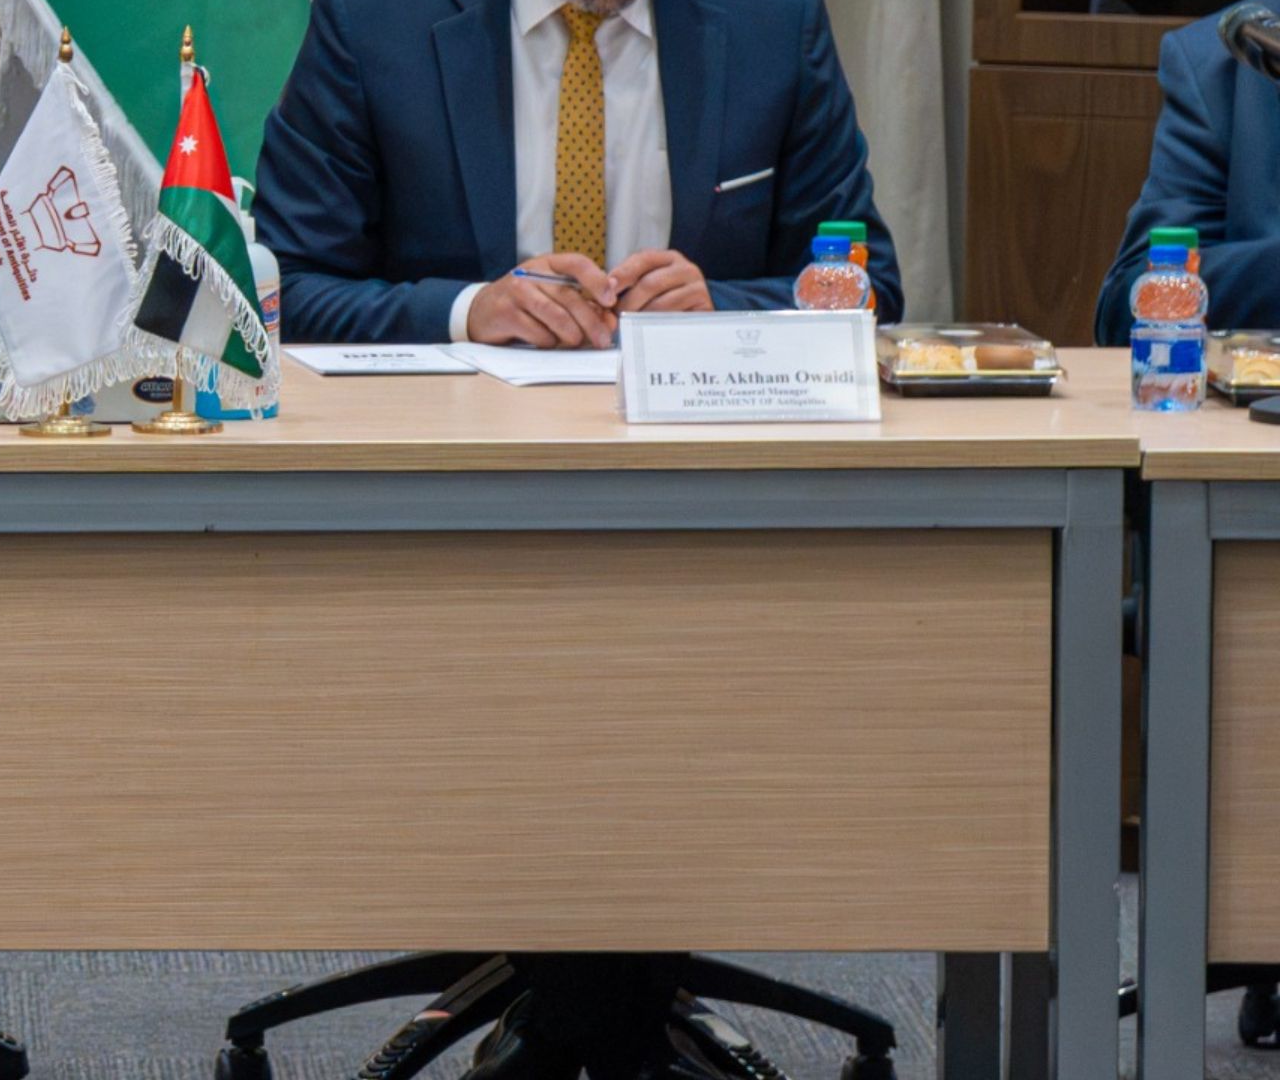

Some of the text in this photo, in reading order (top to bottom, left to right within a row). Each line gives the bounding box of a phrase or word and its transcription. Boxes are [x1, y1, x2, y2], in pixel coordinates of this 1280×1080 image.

[1, 237, 12, 248] of
[6, 249, 31, 301] Antiquities
[649, 370, 854, 386] H.E. Mr. Aktham Owaidi
[697, 387, 808, 398] Acting General Manager
[683, 398, 755, 407] DEPARTMENT
[759, 398, 773, 406] OF
